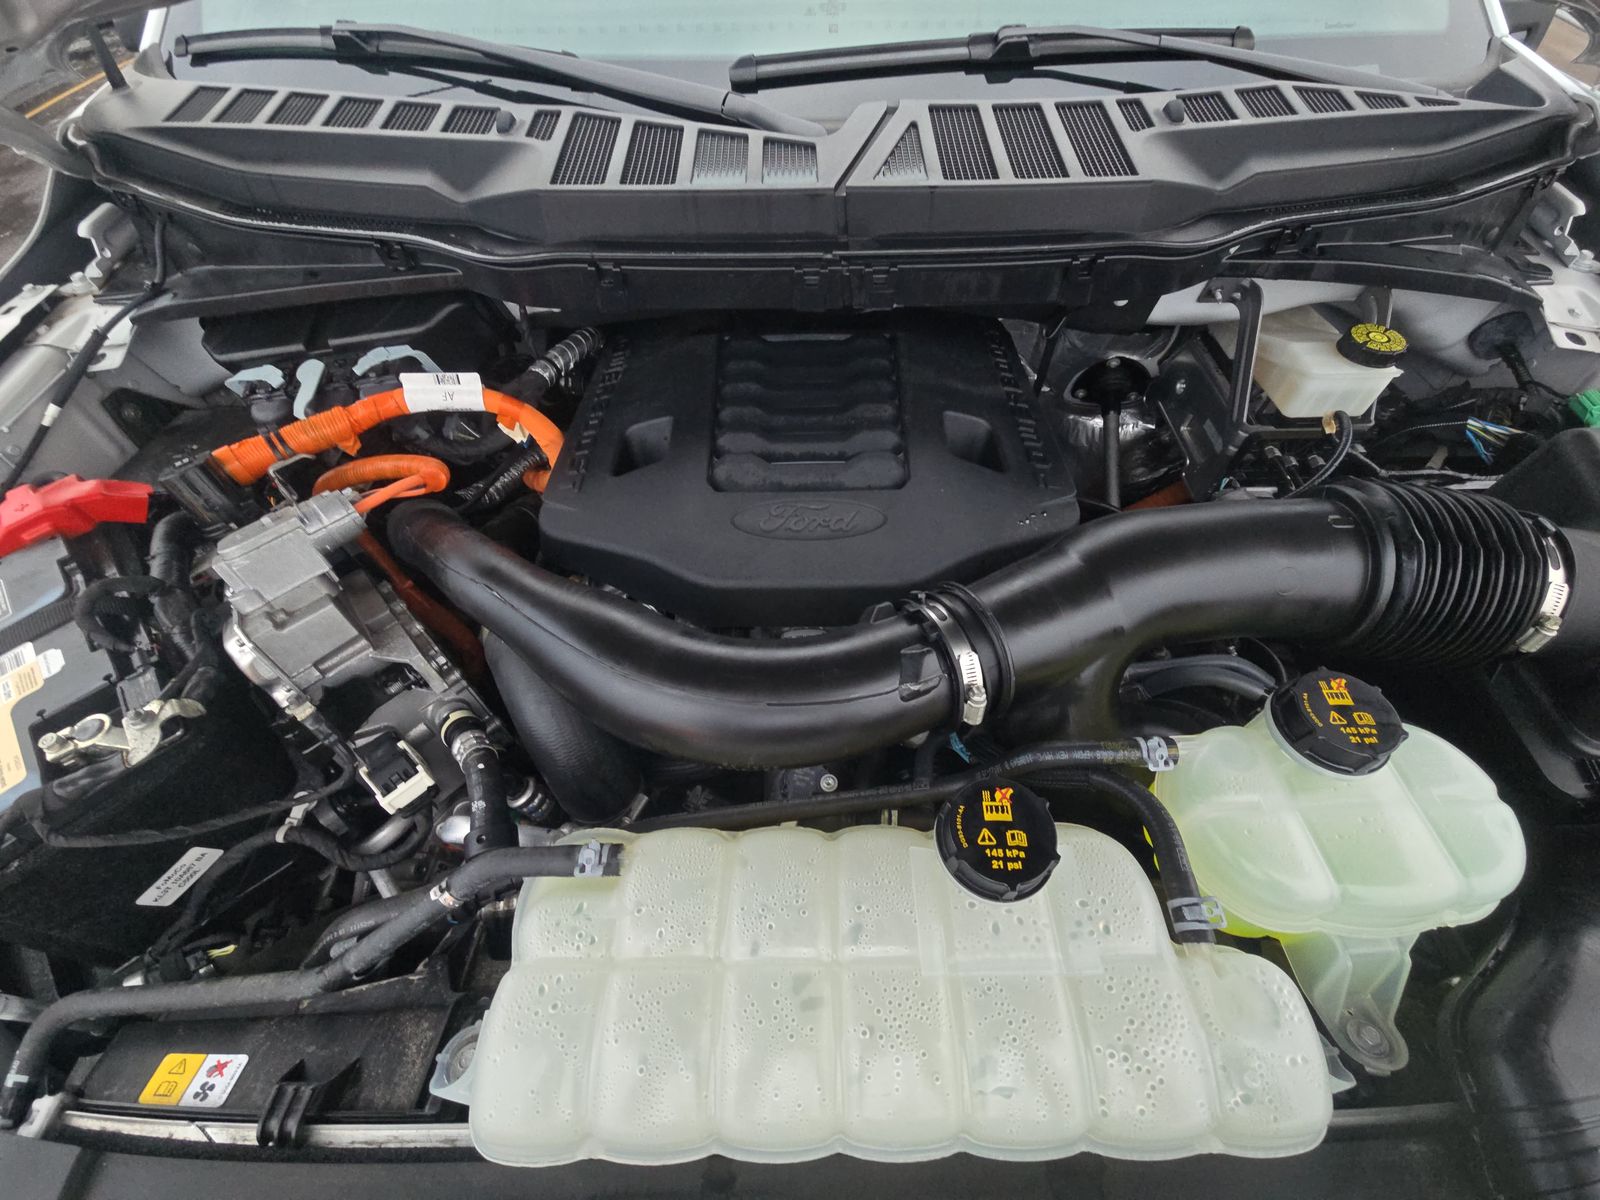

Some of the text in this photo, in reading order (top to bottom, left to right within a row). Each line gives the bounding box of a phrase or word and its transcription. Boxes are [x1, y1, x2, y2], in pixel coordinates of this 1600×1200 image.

[442, 391, 455, 401] AF
[760, 503, 860, 533] Ford
[1349, 736, 1379, 745] 21 psi
[985, 848, 1026, 859] 145 kPa
[991, 861, 1022, 871] 21 psi
